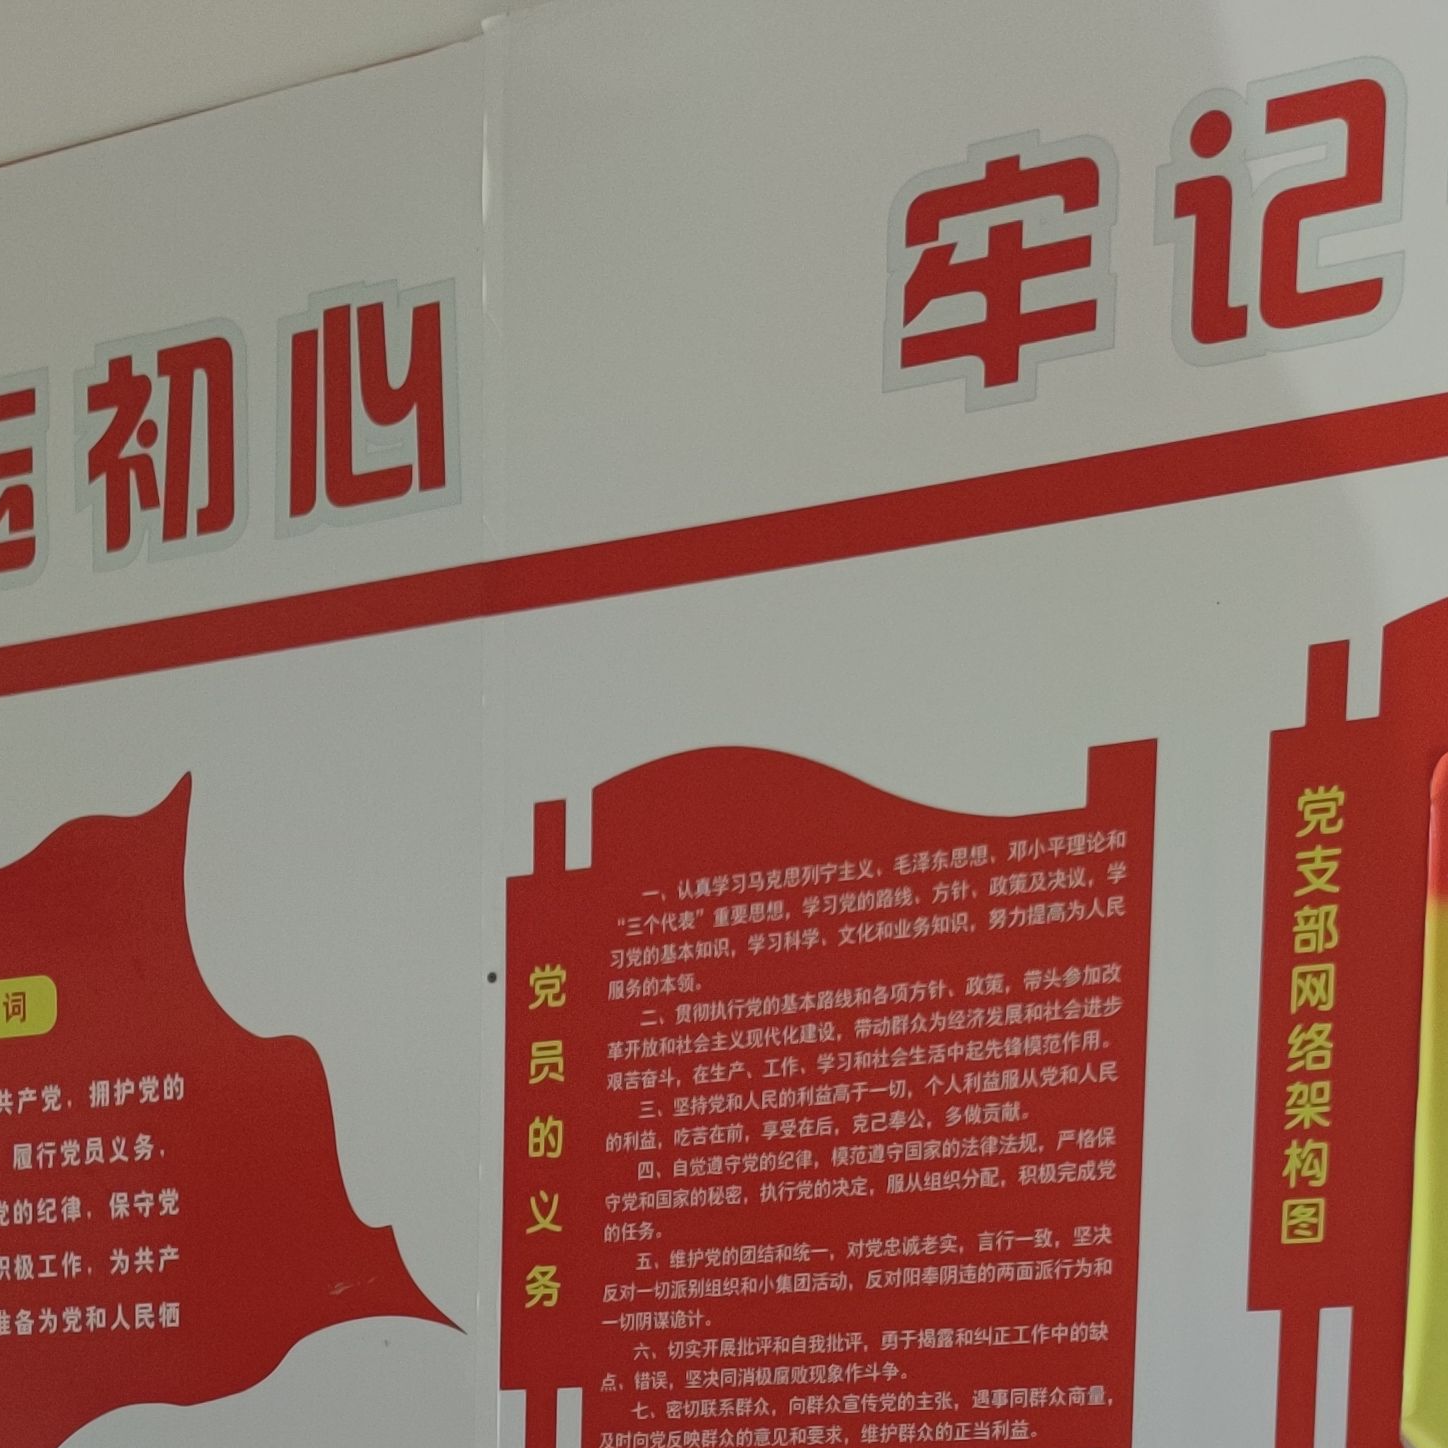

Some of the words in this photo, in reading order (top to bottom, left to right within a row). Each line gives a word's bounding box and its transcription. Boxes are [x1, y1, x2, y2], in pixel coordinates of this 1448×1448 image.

[525, 964, 567, 1308] 党员的义务
[1281, 786, 1345, 1244] 党支部网络架构图
